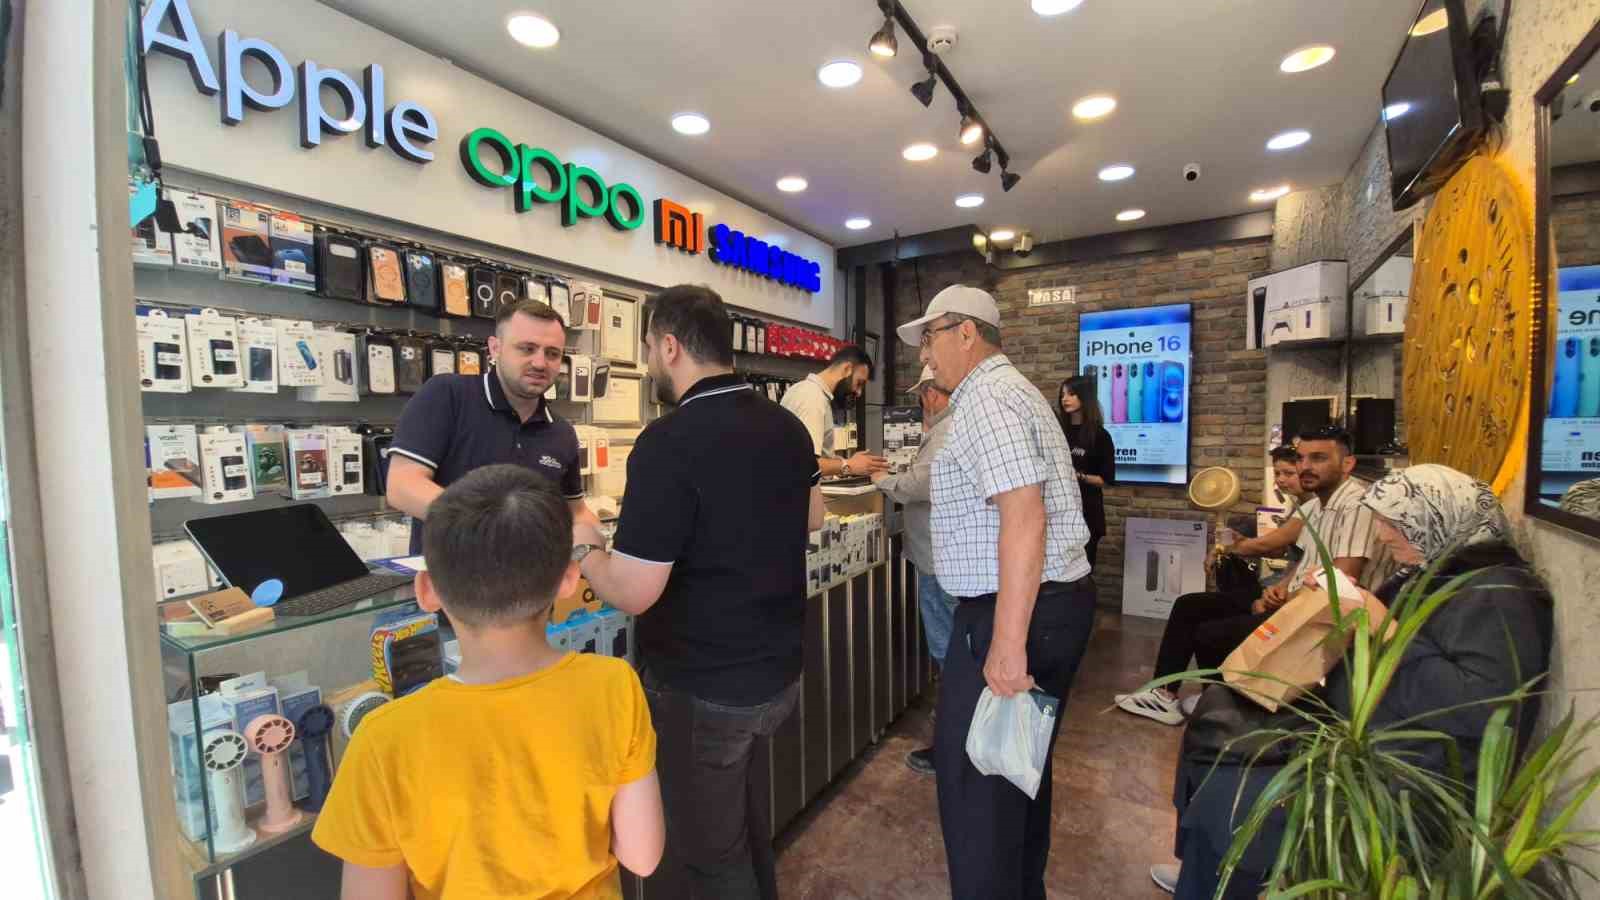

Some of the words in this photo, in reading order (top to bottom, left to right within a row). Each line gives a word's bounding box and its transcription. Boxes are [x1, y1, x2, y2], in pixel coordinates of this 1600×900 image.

[142, 0, 438, 162] Apple
[709, 223, 821, 294] SAMSUNG
[1086, 340, 1153, 356] iPhone
[1158, 335, 1181, 352] 16
[1116, 448, 1137, 456] ren
